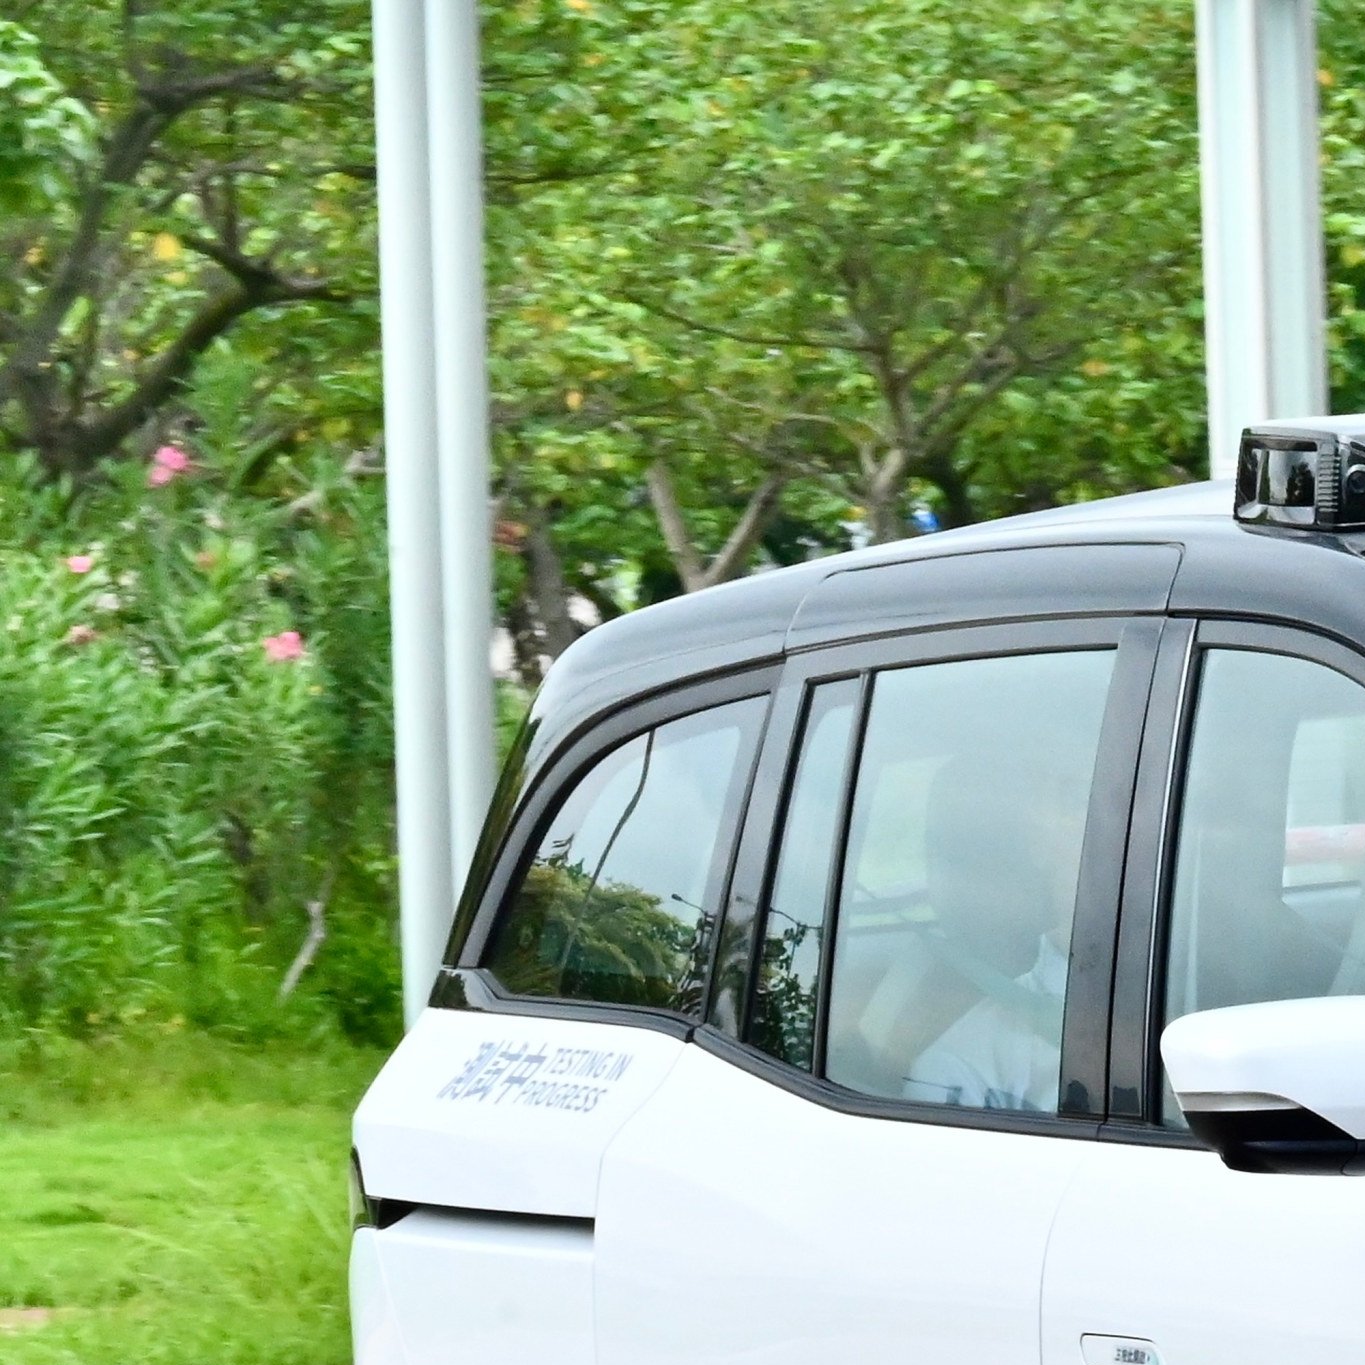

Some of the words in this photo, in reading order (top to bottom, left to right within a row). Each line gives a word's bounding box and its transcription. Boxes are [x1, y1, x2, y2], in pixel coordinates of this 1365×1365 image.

[546, 1047, 613, 1079] TESTING
[605, 1052, 634, 1082] IN
[514, 1080, 608, 1113] PROGRESS
